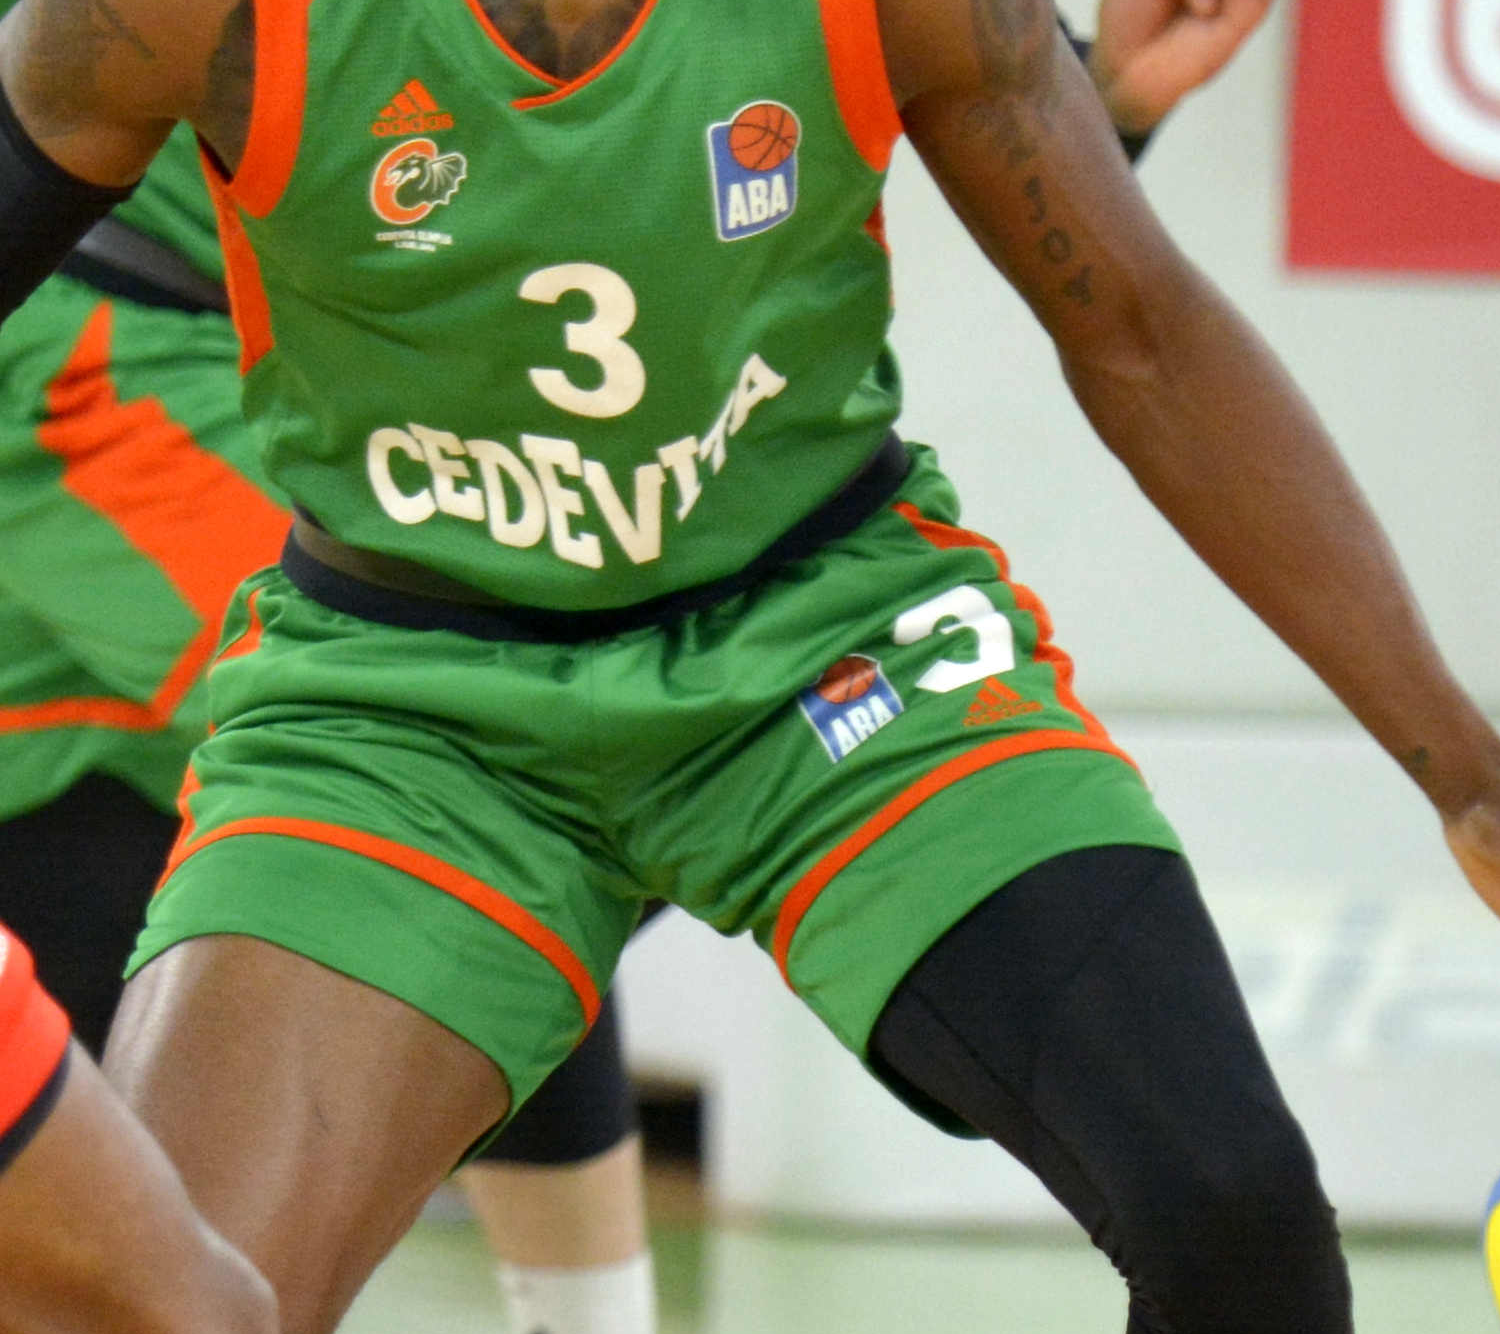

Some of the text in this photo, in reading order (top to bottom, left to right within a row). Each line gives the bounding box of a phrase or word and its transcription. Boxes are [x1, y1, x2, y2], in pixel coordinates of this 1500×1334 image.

[371, 113, 455, 137] adidas
[727, 173, 791, 231] ABA
[518, 262, 646, 419] 3
[367, 353, 788, 569] CEDEVITA
[893, 585, 1015, 693] 3
[963, 700, 1043, 727] adidas
